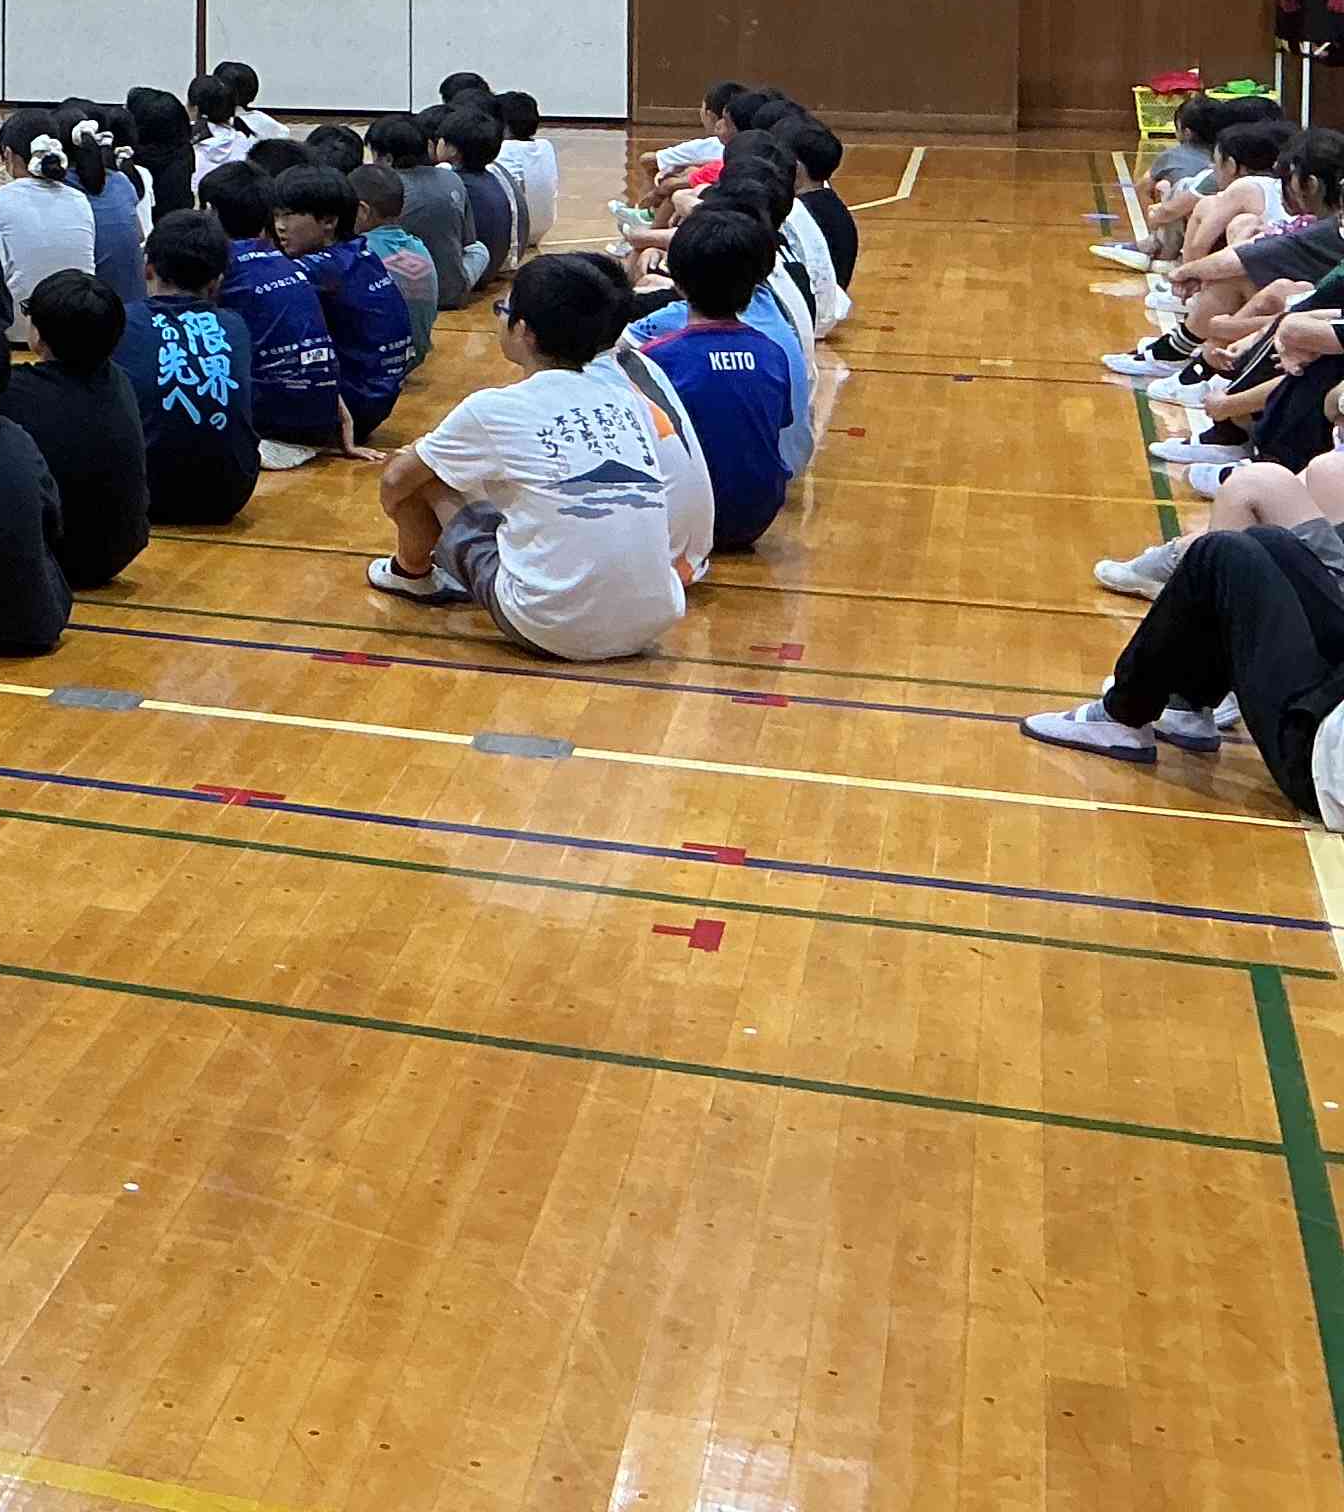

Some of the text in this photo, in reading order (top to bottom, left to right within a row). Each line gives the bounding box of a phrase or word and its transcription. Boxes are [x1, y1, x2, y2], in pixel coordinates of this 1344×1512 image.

[152, 313, 201, 425] その先へ
[177, 310, 240, 431] 限界の
[708, 351, 756, 371] KEITO
